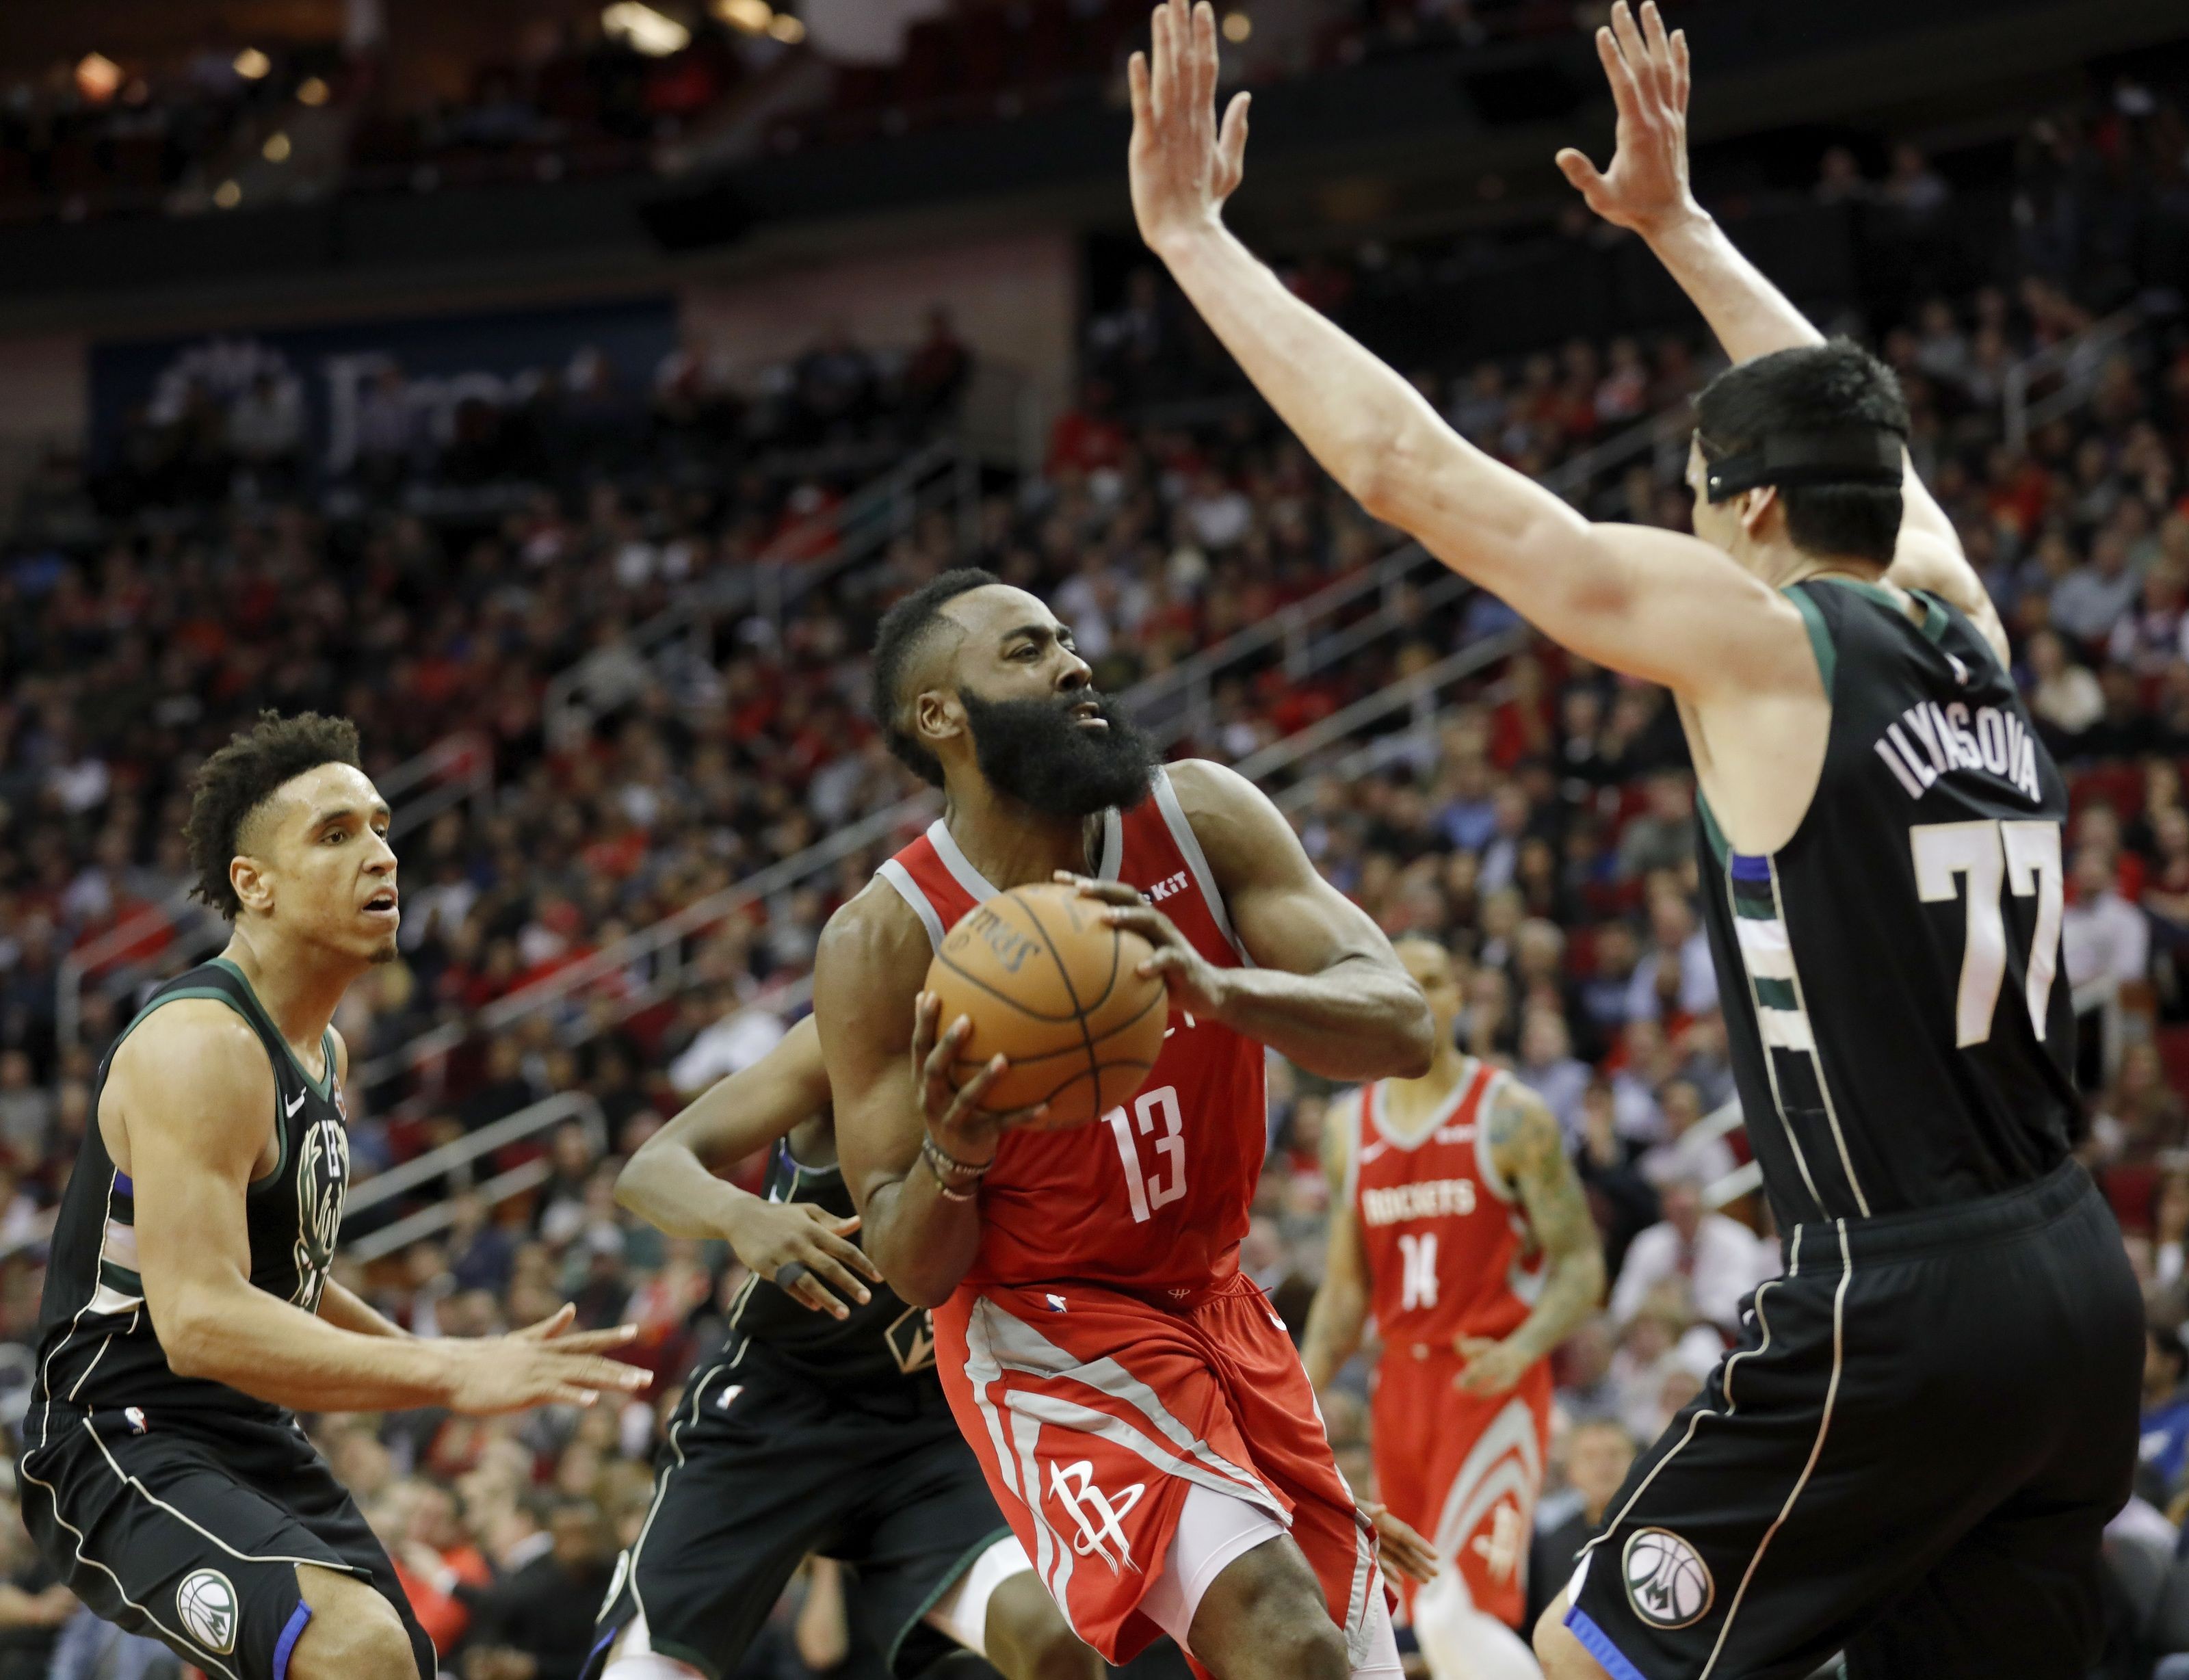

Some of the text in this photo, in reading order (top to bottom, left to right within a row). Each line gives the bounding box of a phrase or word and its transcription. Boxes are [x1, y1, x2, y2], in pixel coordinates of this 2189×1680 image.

[1874, 700, 2041, 803] ILYASOVA
[1910, 819, 2063, 1049] 77
[1101, 1085, 1188, 1224] 13
